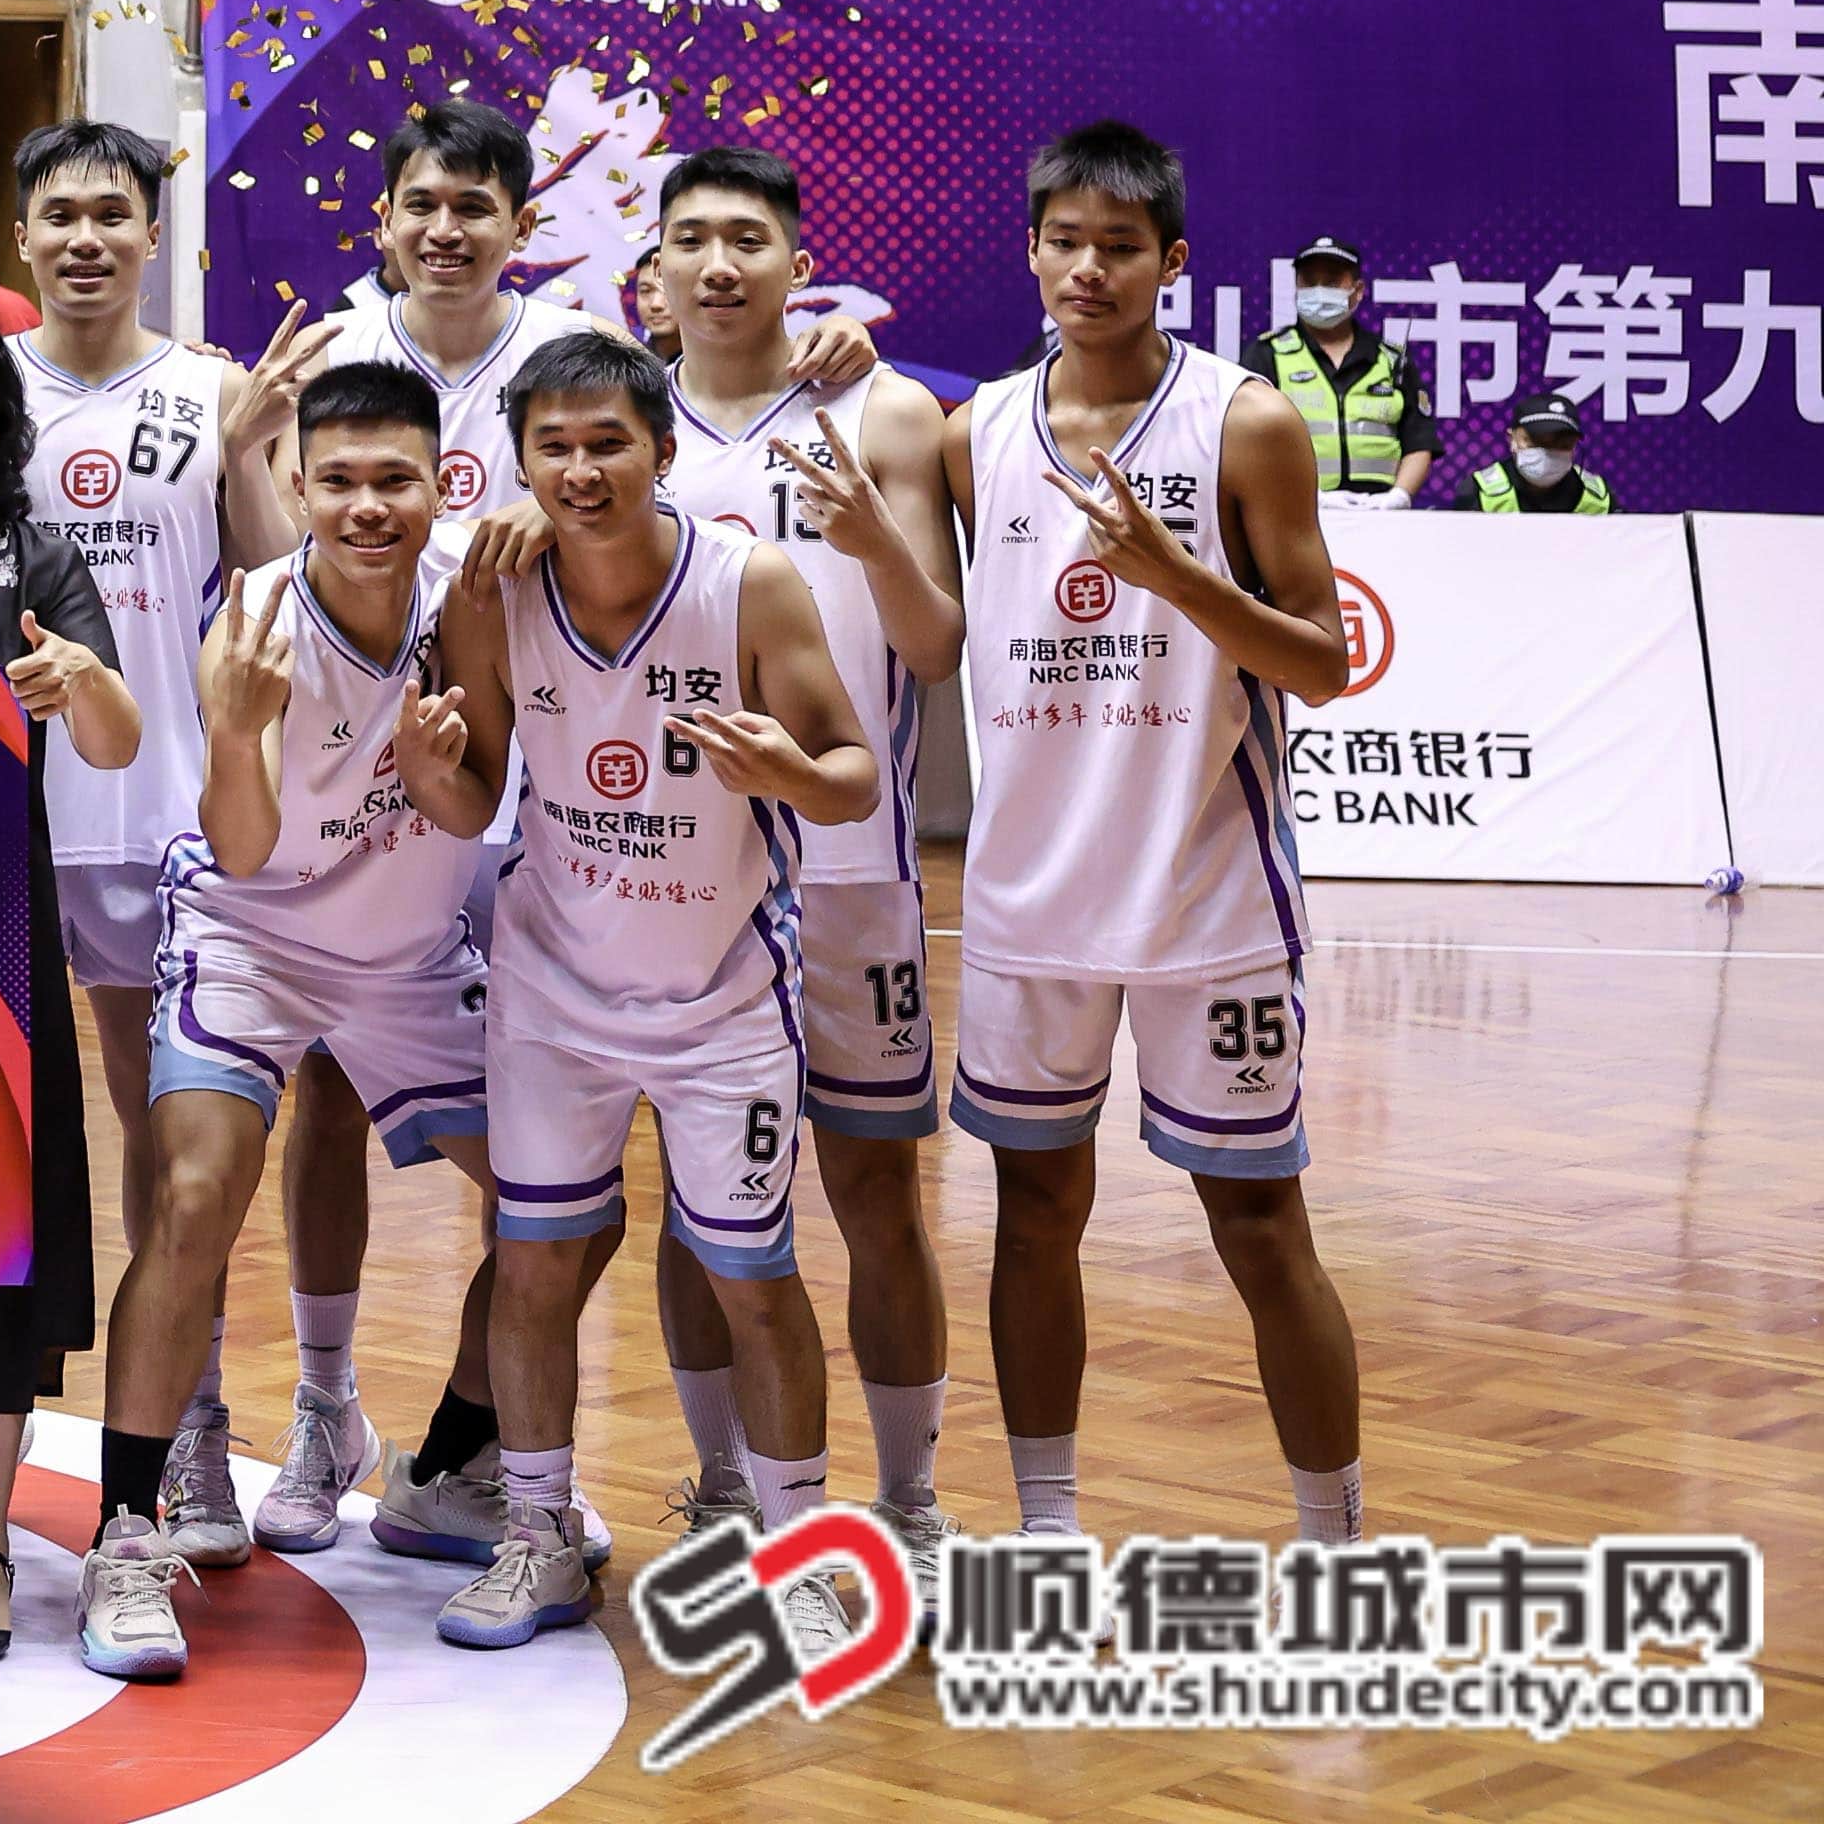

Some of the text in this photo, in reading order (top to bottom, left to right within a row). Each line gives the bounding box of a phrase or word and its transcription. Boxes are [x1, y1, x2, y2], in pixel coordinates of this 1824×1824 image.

[137, 387, 204, 430] 均安
[126, 419, 201, 487] 67
[86, 548, 135, 567] BANK
[1008, 634, 1169, 662] 南海农商银行
[645, 664, 722, 706] 均安
[1028, 662, 1142, 685] NRC BANK
[523, 703, 568, 716] CYNDICAT
[662, 712, 701, 778] 6
[1336, 790, 1479, 828] BANK
[568, 829, 614, 854] NRC
[863, 960, 922, 1027] 13
[1205, 993, 1290, 1061] 35
[1225, 1083, 1278, 1095] CYNDICAT
[743, 1097, 782, 1164] 6
[727, 1190, 776, 1203] CYNDICAT
